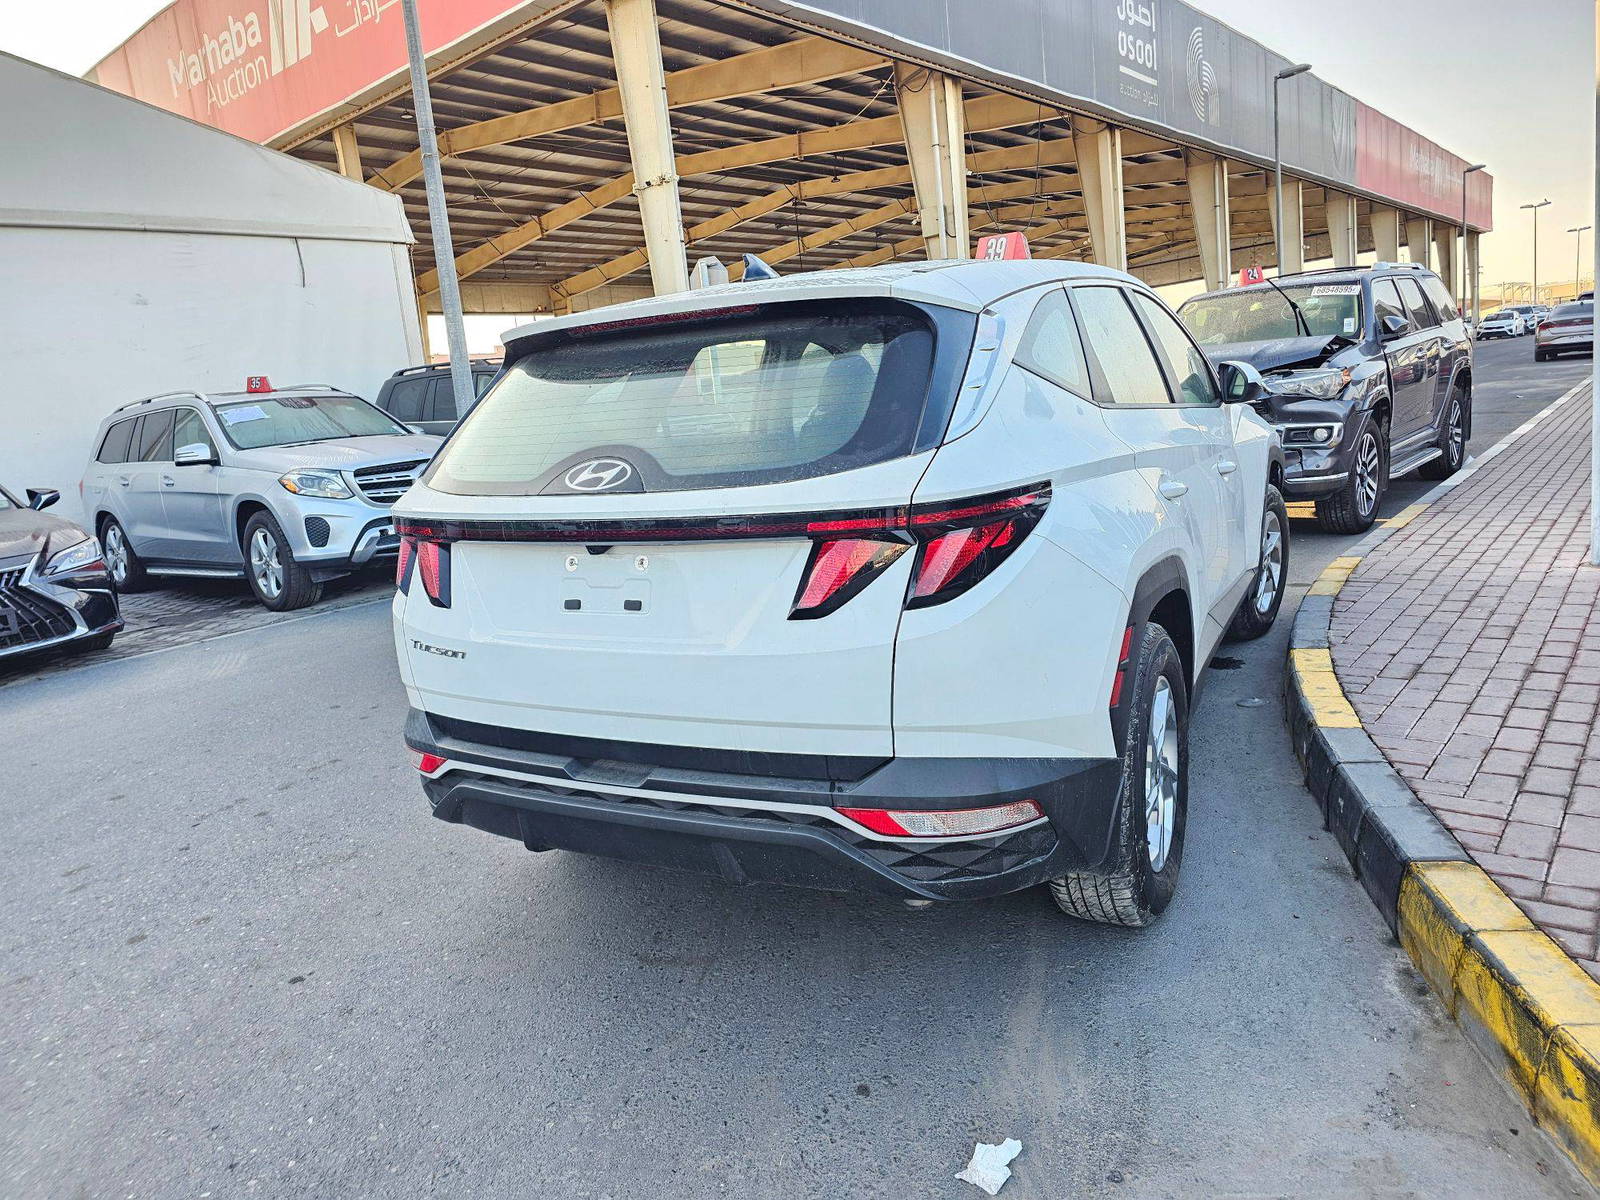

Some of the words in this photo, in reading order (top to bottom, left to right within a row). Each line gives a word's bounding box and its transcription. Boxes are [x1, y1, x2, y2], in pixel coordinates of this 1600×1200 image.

[167, 11, 262, 99] Marhaba
[1117, 30, 1157, 71] asool
[207, 55, 269, 116] Auction
[984, 236, 1008, 261] 39
[1247, 268, 1259, 281] 24
[250, 377, 262, 389] 35
